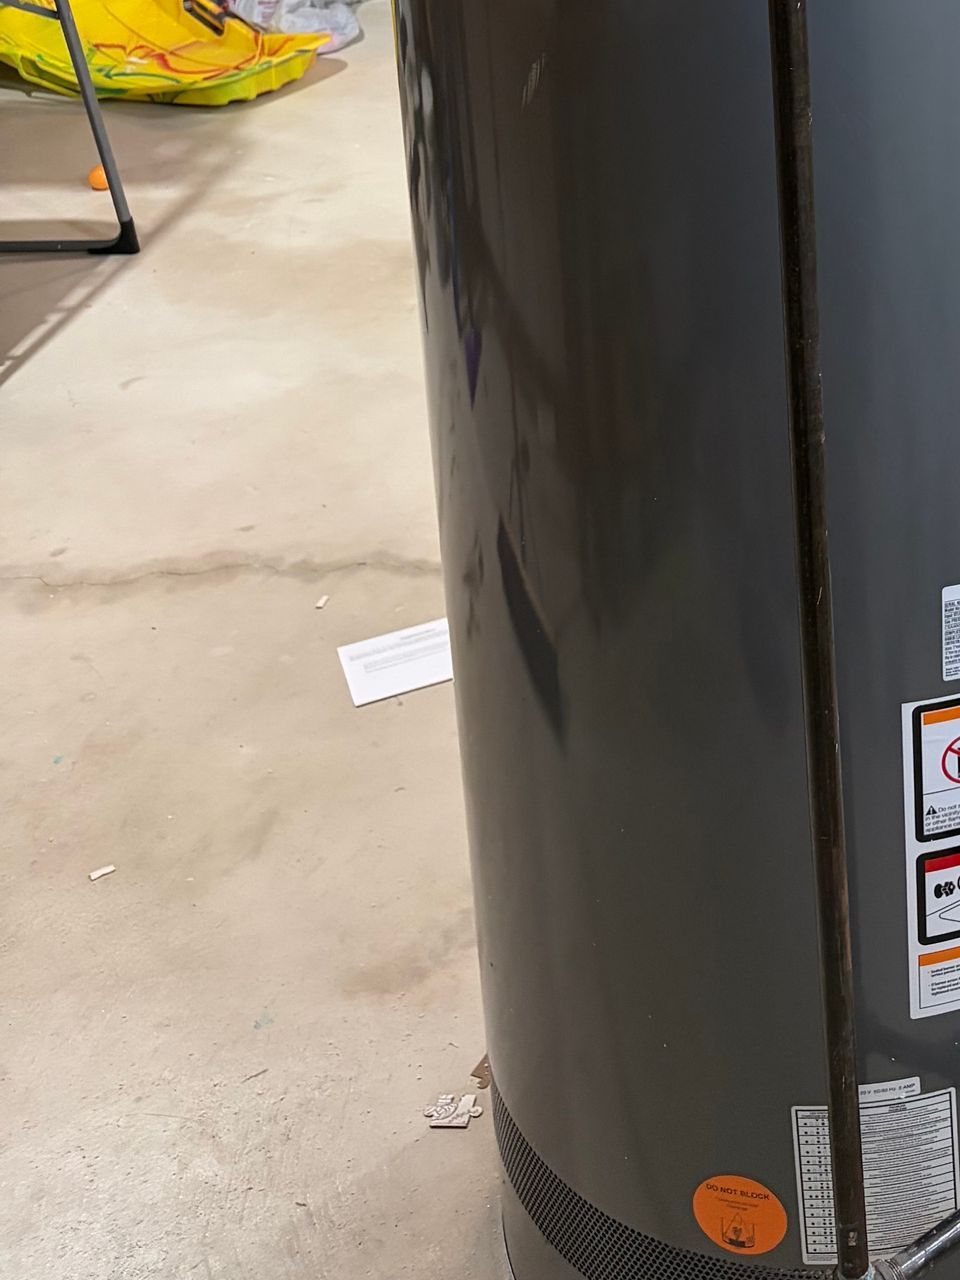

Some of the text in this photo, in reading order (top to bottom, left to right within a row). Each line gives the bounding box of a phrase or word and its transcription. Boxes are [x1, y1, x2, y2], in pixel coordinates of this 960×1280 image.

[706, 1184, 770, 1200] DO NOT BLOCK
